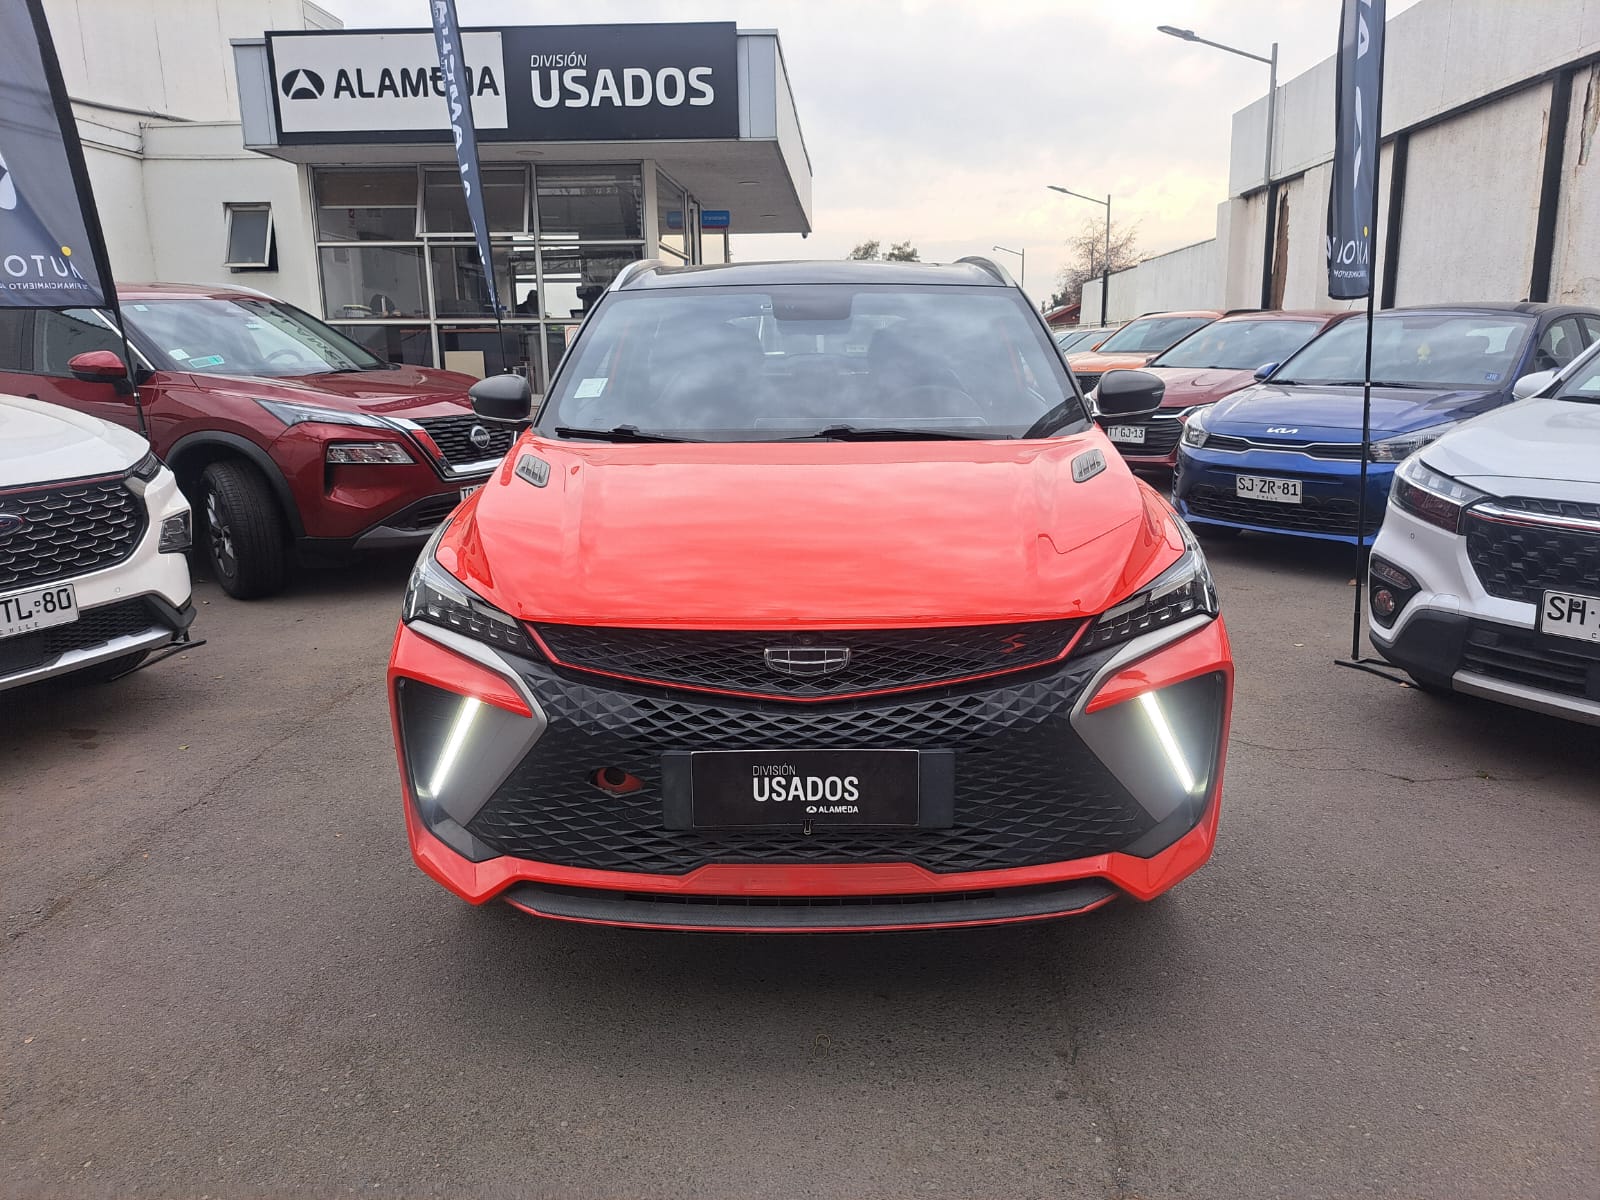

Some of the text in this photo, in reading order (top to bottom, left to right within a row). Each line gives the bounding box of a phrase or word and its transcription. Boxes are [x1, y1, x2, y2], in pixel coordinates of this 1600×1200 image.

[530, 51, 588, 68] DIVISIÓN
[530, 66, 715, 109] USADOS
[752, 762, 796, 776] DIVISIÓN
[753, 776, 859, 802] USADOS
[818, 805, 859, 814] ALAMEDA
